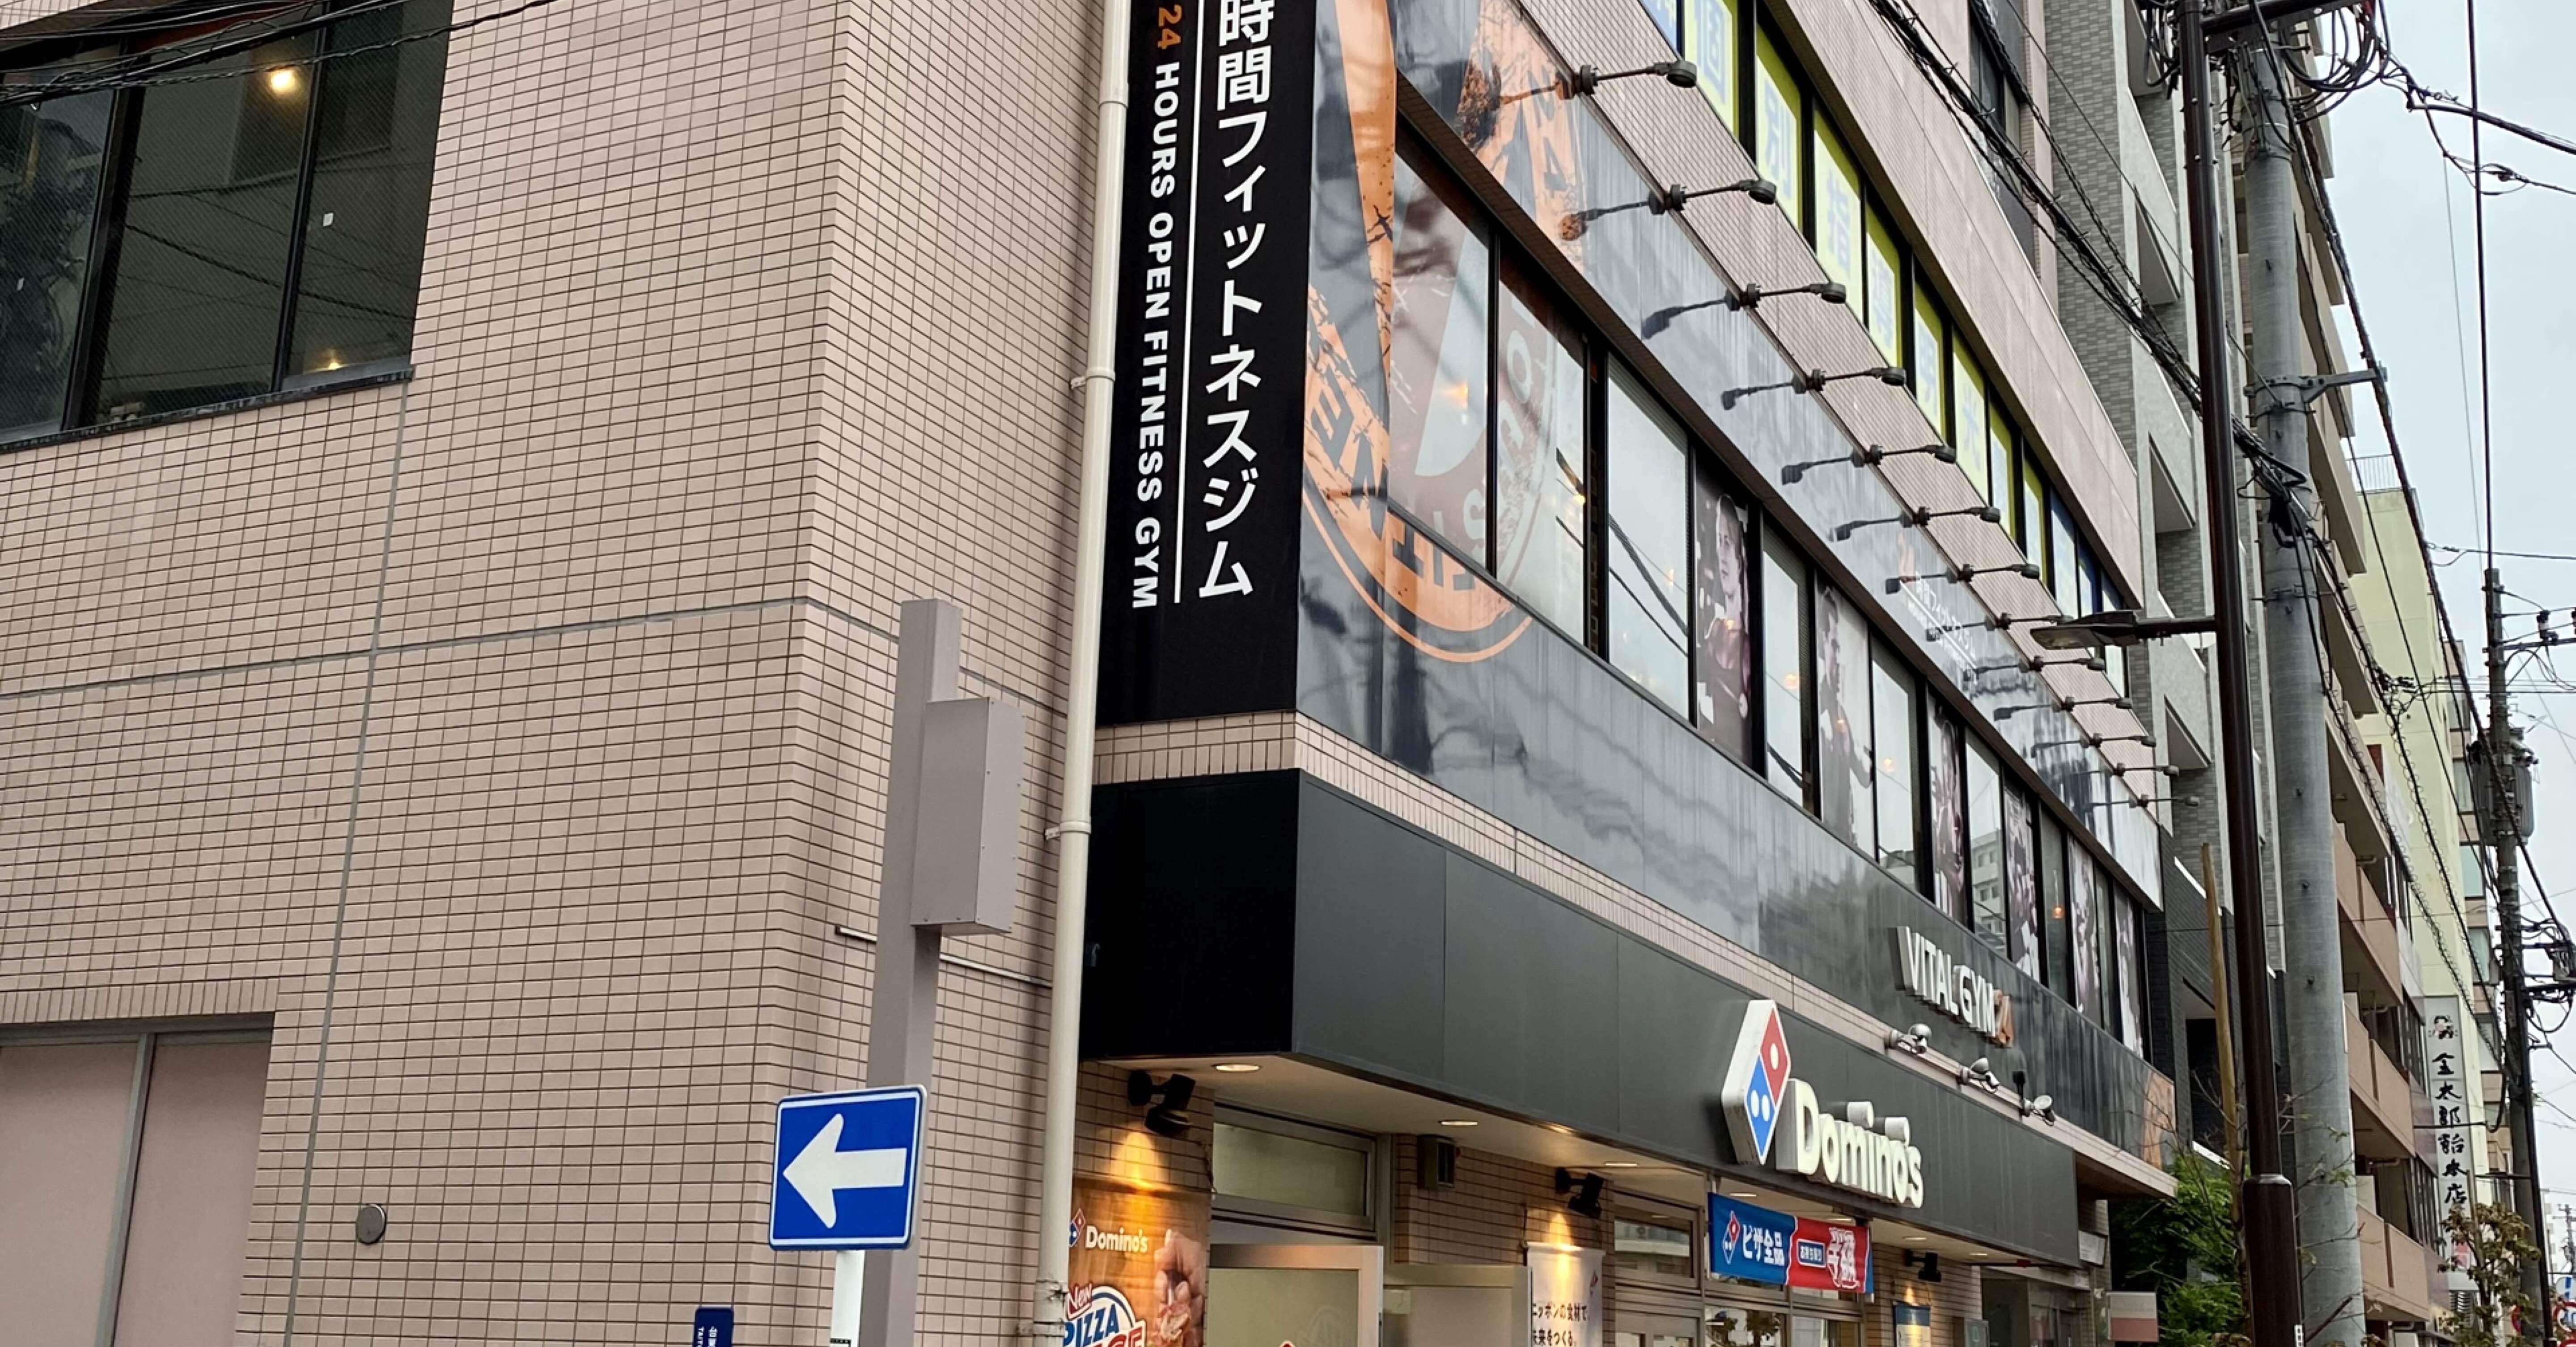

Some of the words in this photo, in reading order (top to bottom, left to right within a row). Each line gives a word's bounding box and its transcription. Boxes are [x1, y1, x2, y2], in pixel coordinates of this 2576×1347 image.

[1157, 5, 1182, 50] 24
[1151, 62, 1181, 199] HOURS
[1144, 212, 1174, 319] OPEN
[1137, 330, 1169, 502] FITNESS
[1132, 517, 1161, 608] GYM
[1897, 926, 1958, 1016] VITAL
[1776, 1079, 1924, 1208] Domino's
[2432, 1052, 2467, 1203] 金太郎飴本店
[1085, 1225, 1148, 1253] Domino's
[1742, 1224, 1785, 1267] ピザ全品
